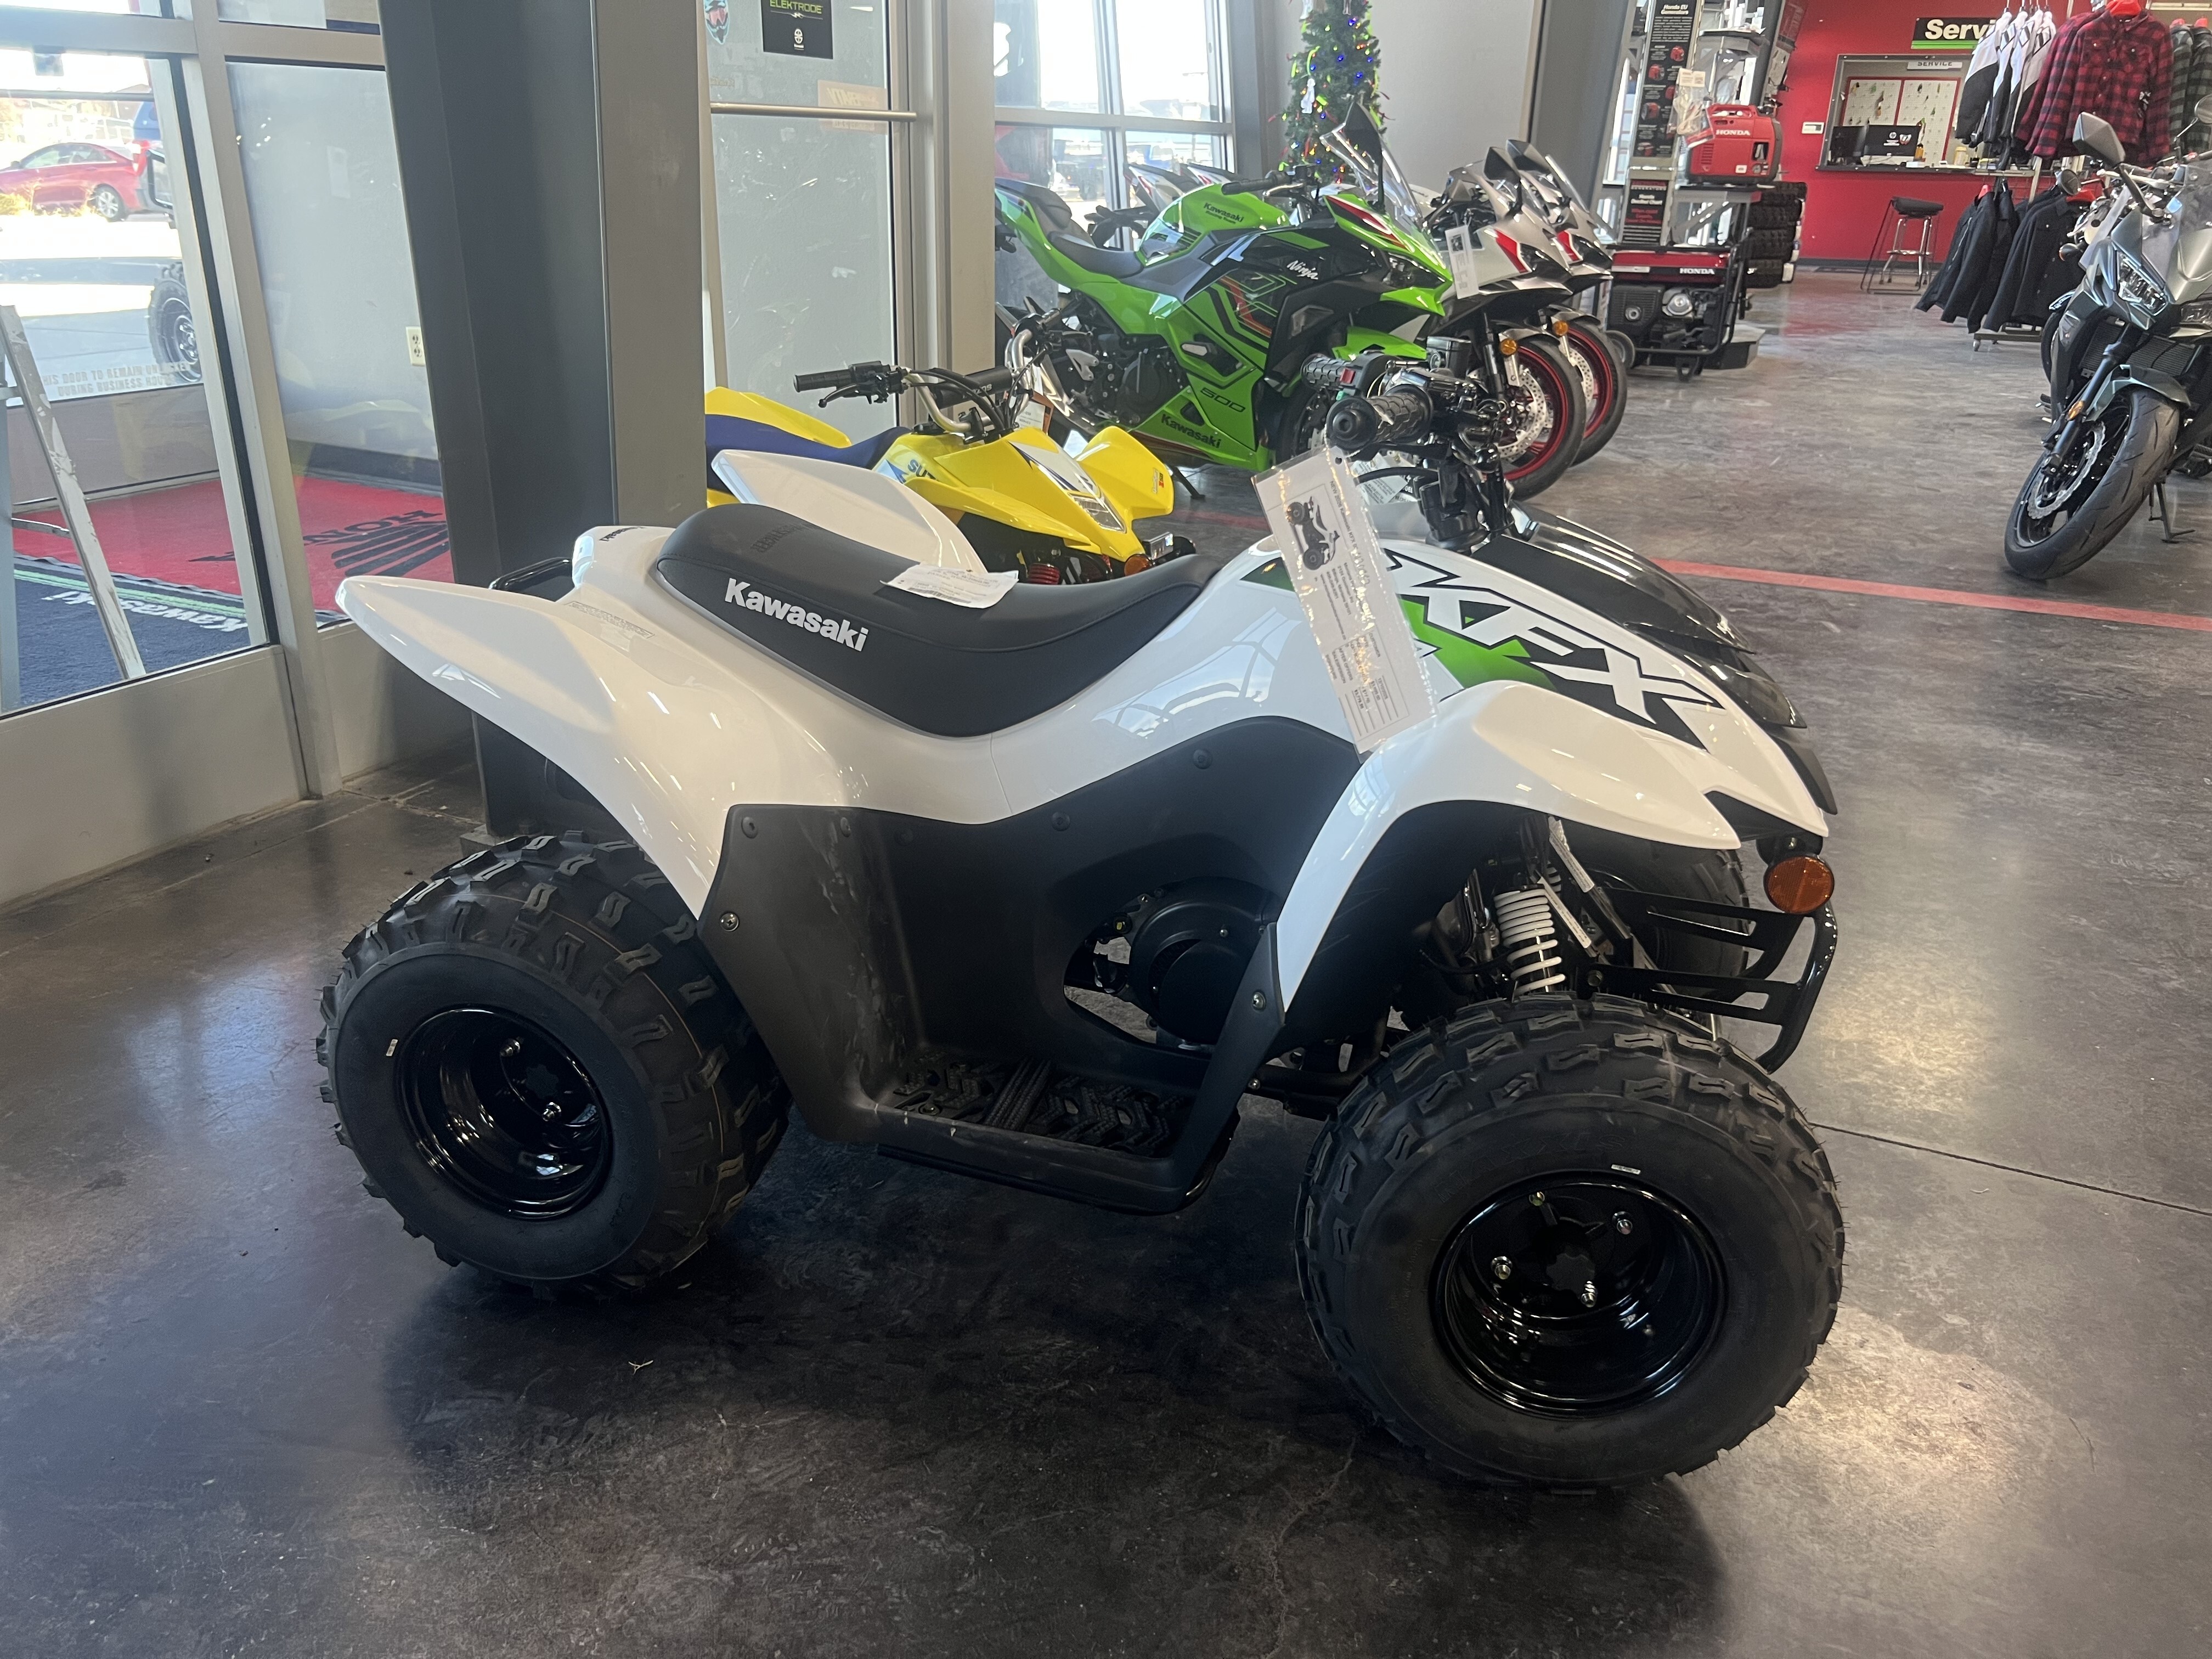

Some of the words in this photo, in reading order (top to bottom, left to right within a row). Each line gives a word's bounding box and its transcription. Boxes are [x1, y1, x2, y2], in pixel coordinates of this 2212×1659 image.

[770, 0, 822, 14] ELEKTRODE
[1204, 202, 1244, 223] Kawasaki
[1286, 259, 1318, 280] Ninja
[43, 374, 59, 386] HIS
[1200, 387, 1246, 413] 500
[1161, 414, 1222, 448] Kawasaki
[1329, 481, 1338, 494] NEW
[42, 590, 247, 632] Kawaski
[724, 578, 870, 653] Kawasaki
